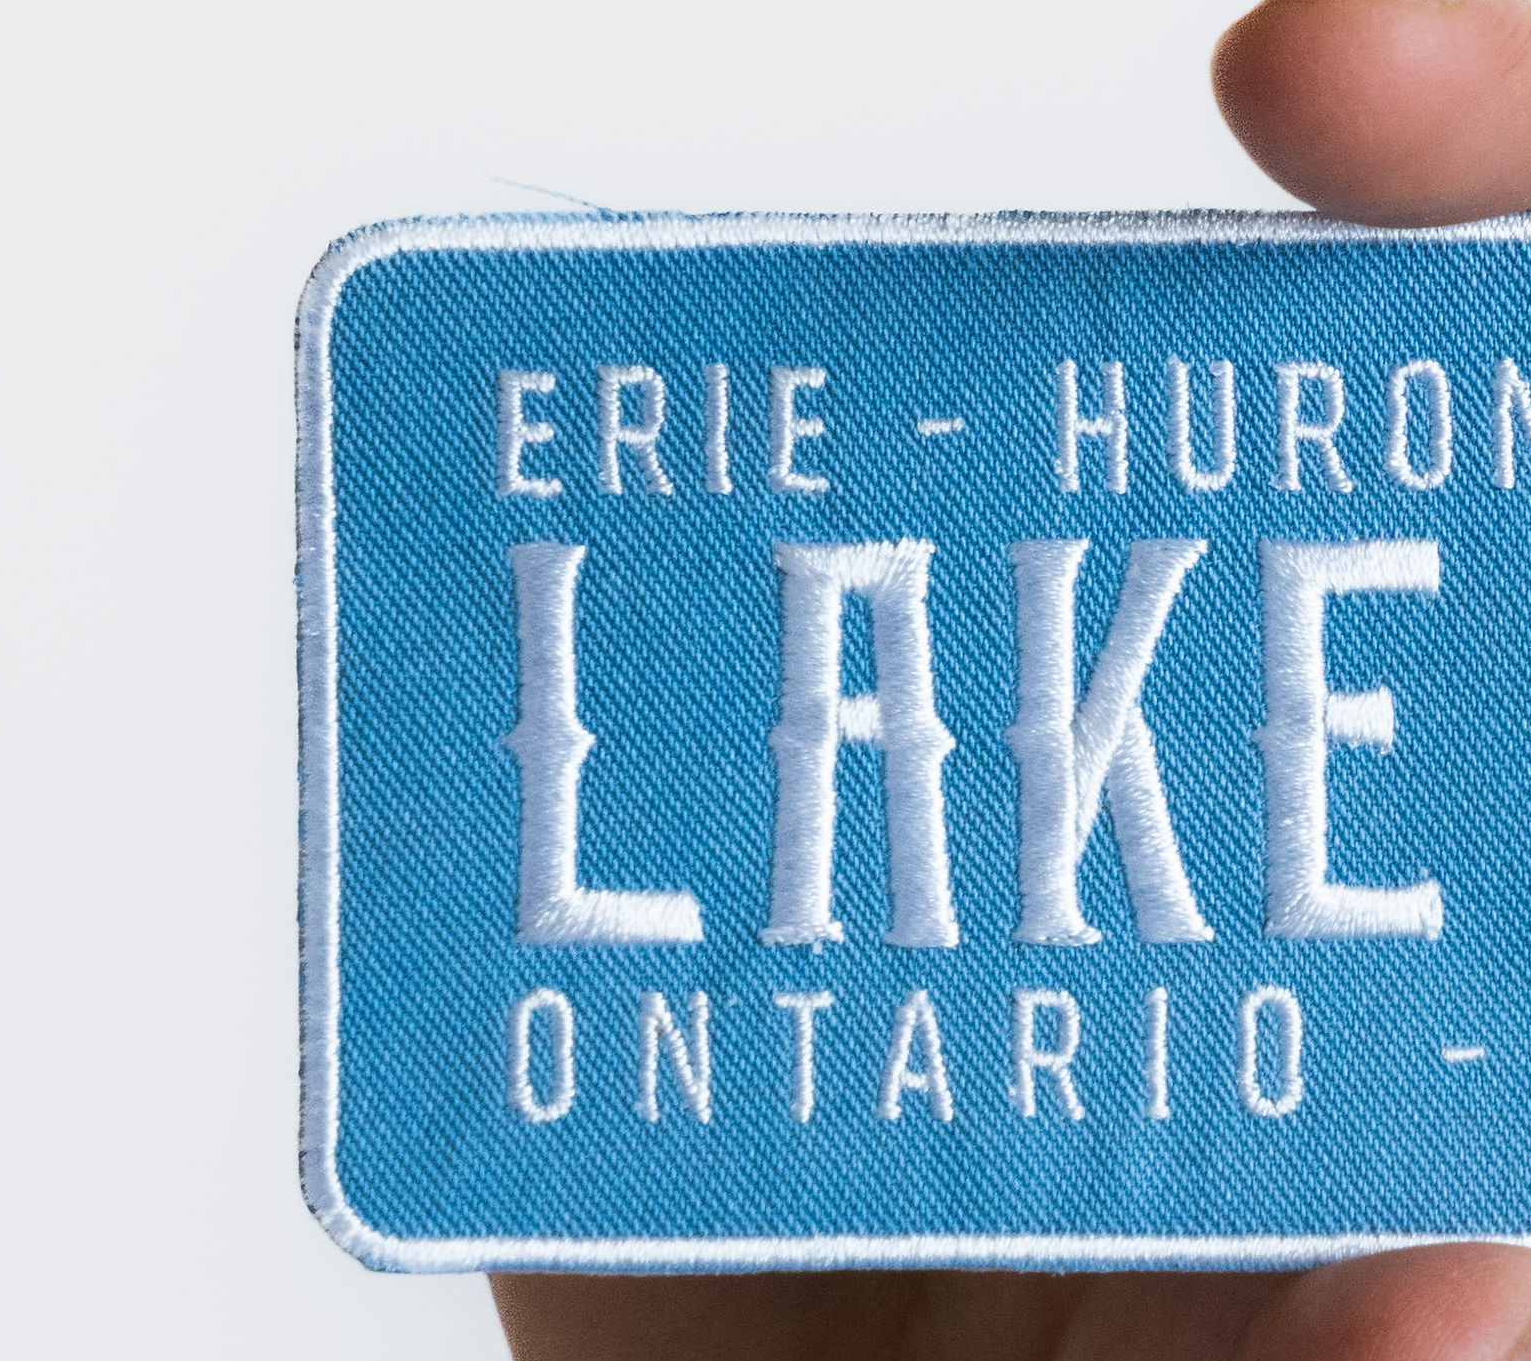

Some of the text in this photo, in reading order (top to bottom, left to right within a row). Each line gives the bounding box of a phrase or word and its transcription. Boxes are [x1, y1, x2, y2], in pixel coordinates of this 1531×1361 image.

[500, 361, 831, 500] ERIE
[507, 535, 1447, 949] LAKE
[508, 981, 1309, 1126] ONTARIO
